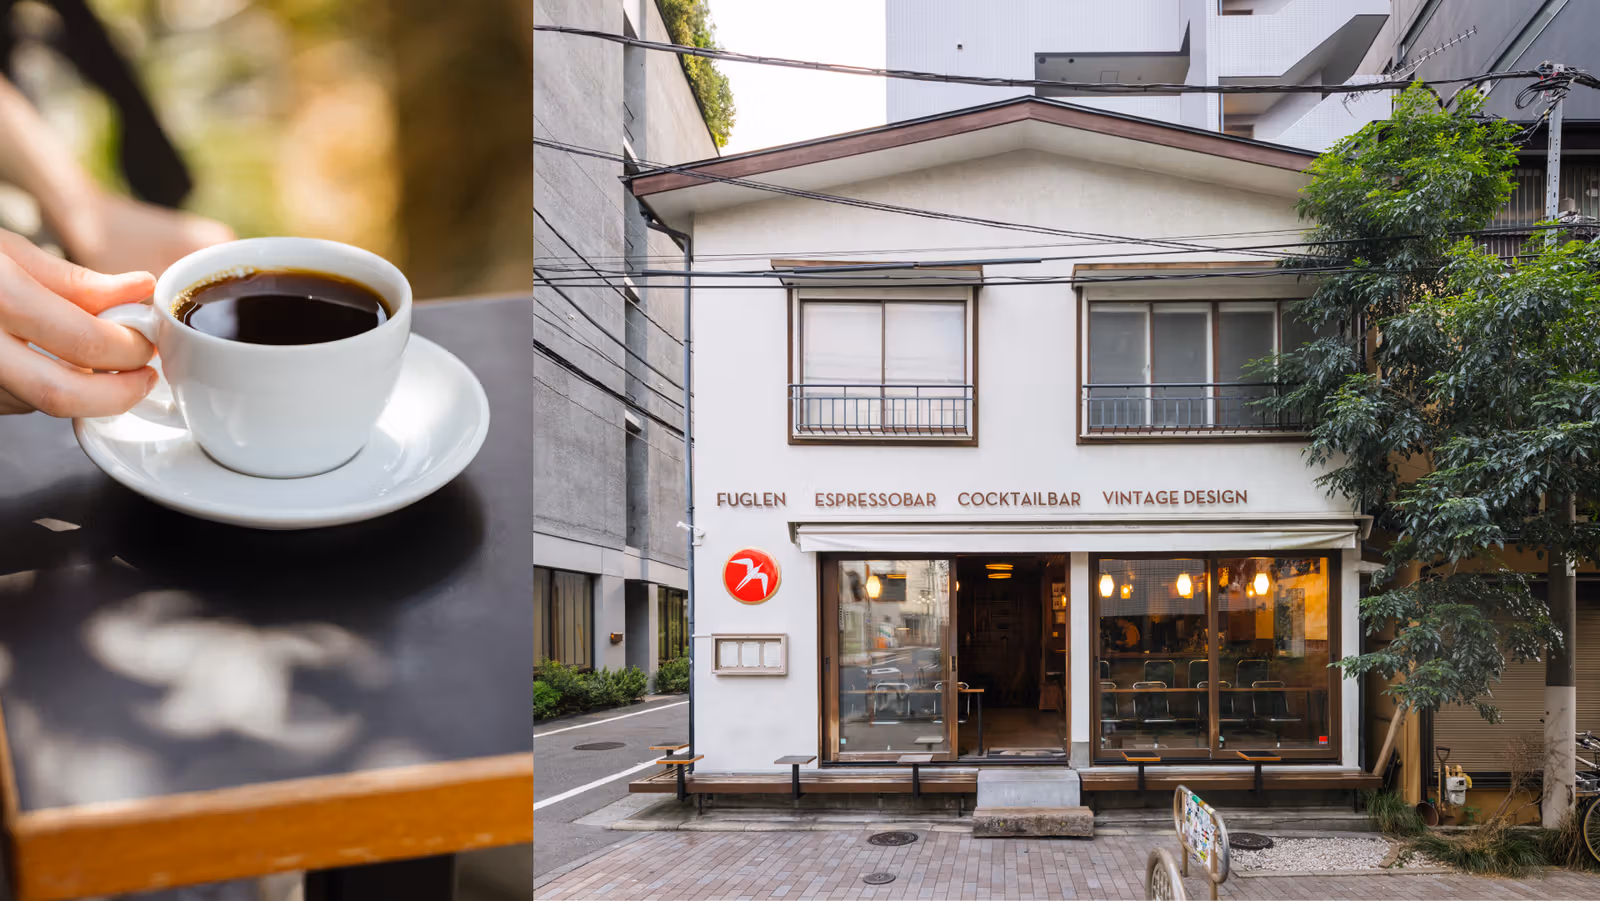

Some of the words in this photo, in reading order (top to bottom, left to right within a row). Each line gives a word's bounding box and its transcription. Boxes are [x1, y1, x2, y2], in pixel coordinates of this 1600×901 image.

[717, 492, 786, 507] FUGLEN
[815, 492, 937, 507] ESPRESSOBAR
[957, 491, 1081, 507] COCKTAILBAR
[1102, 490, 1179, 505] VINTAGE
[1183, 489, 1248, 504] DESIGN
